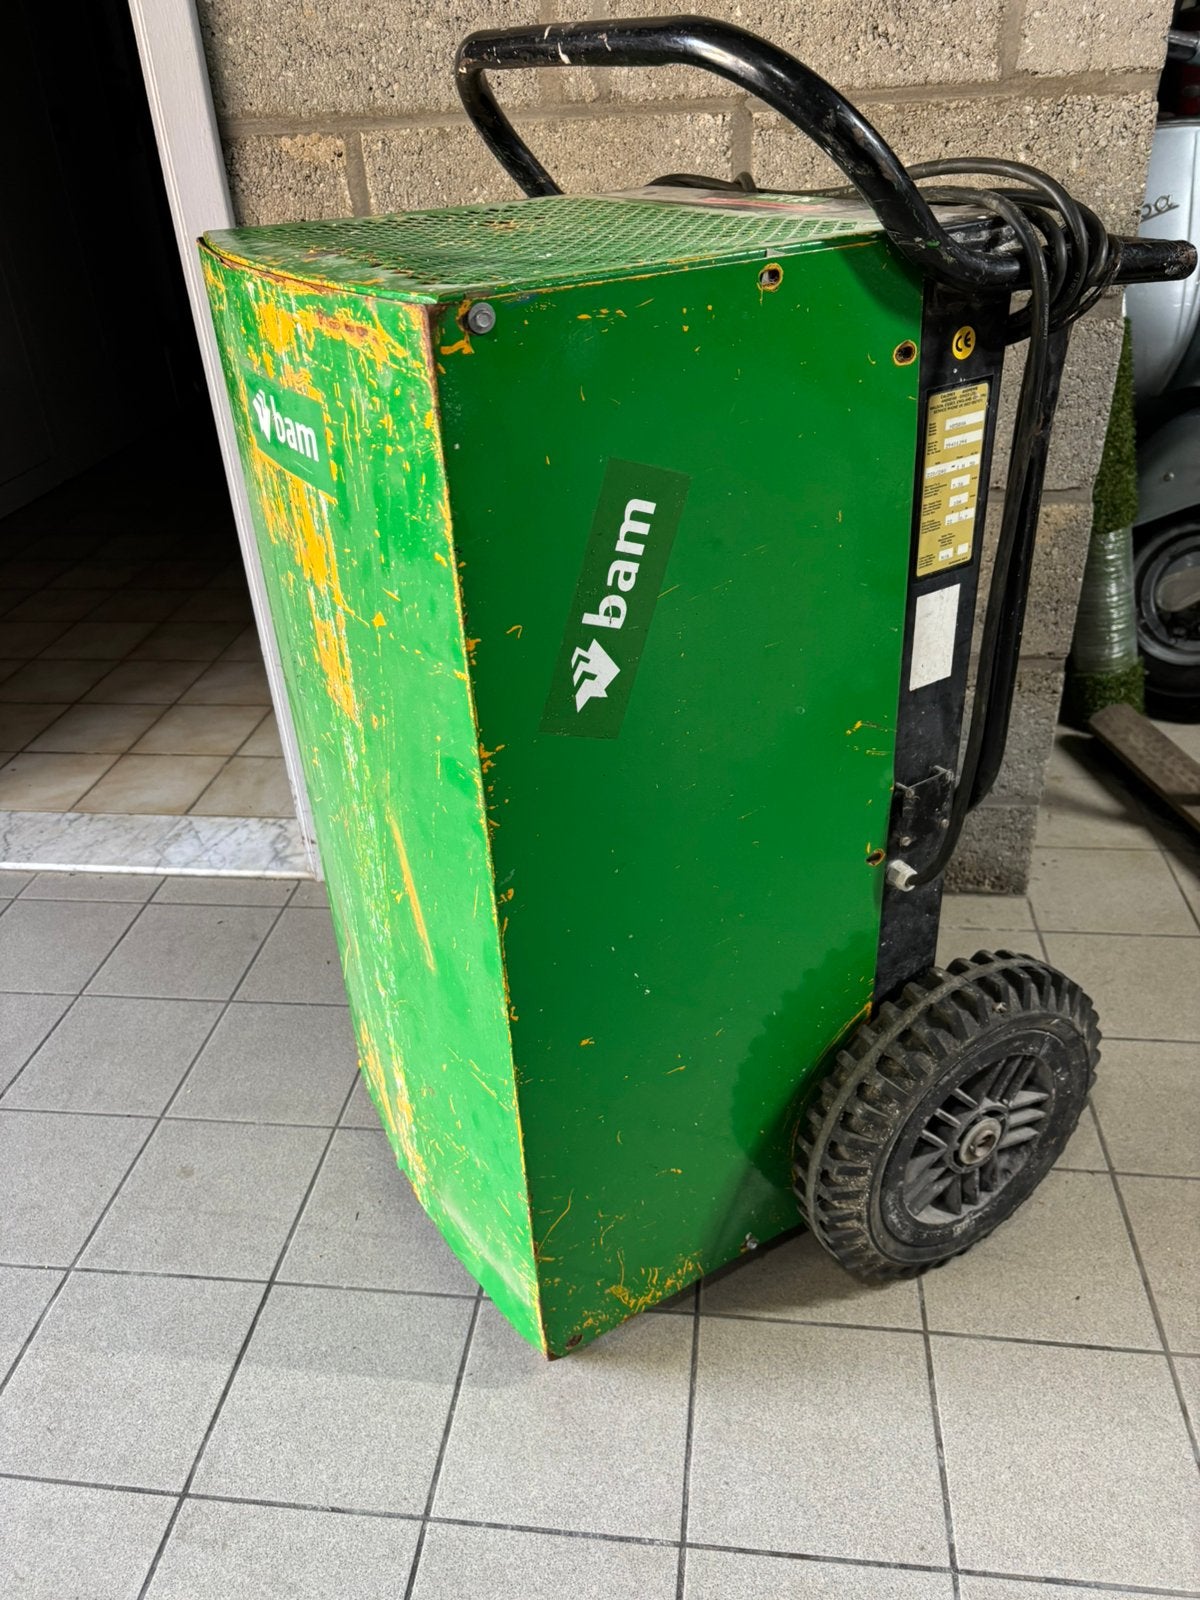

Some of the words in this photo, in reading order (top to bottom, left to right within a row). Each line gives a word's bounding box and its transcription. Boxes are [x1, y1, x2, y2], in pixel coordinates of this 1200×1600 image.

[955, 331, 971, 352] CE
[270, 395, 319, 462] bam
[582, 499, 657, 629] bam
